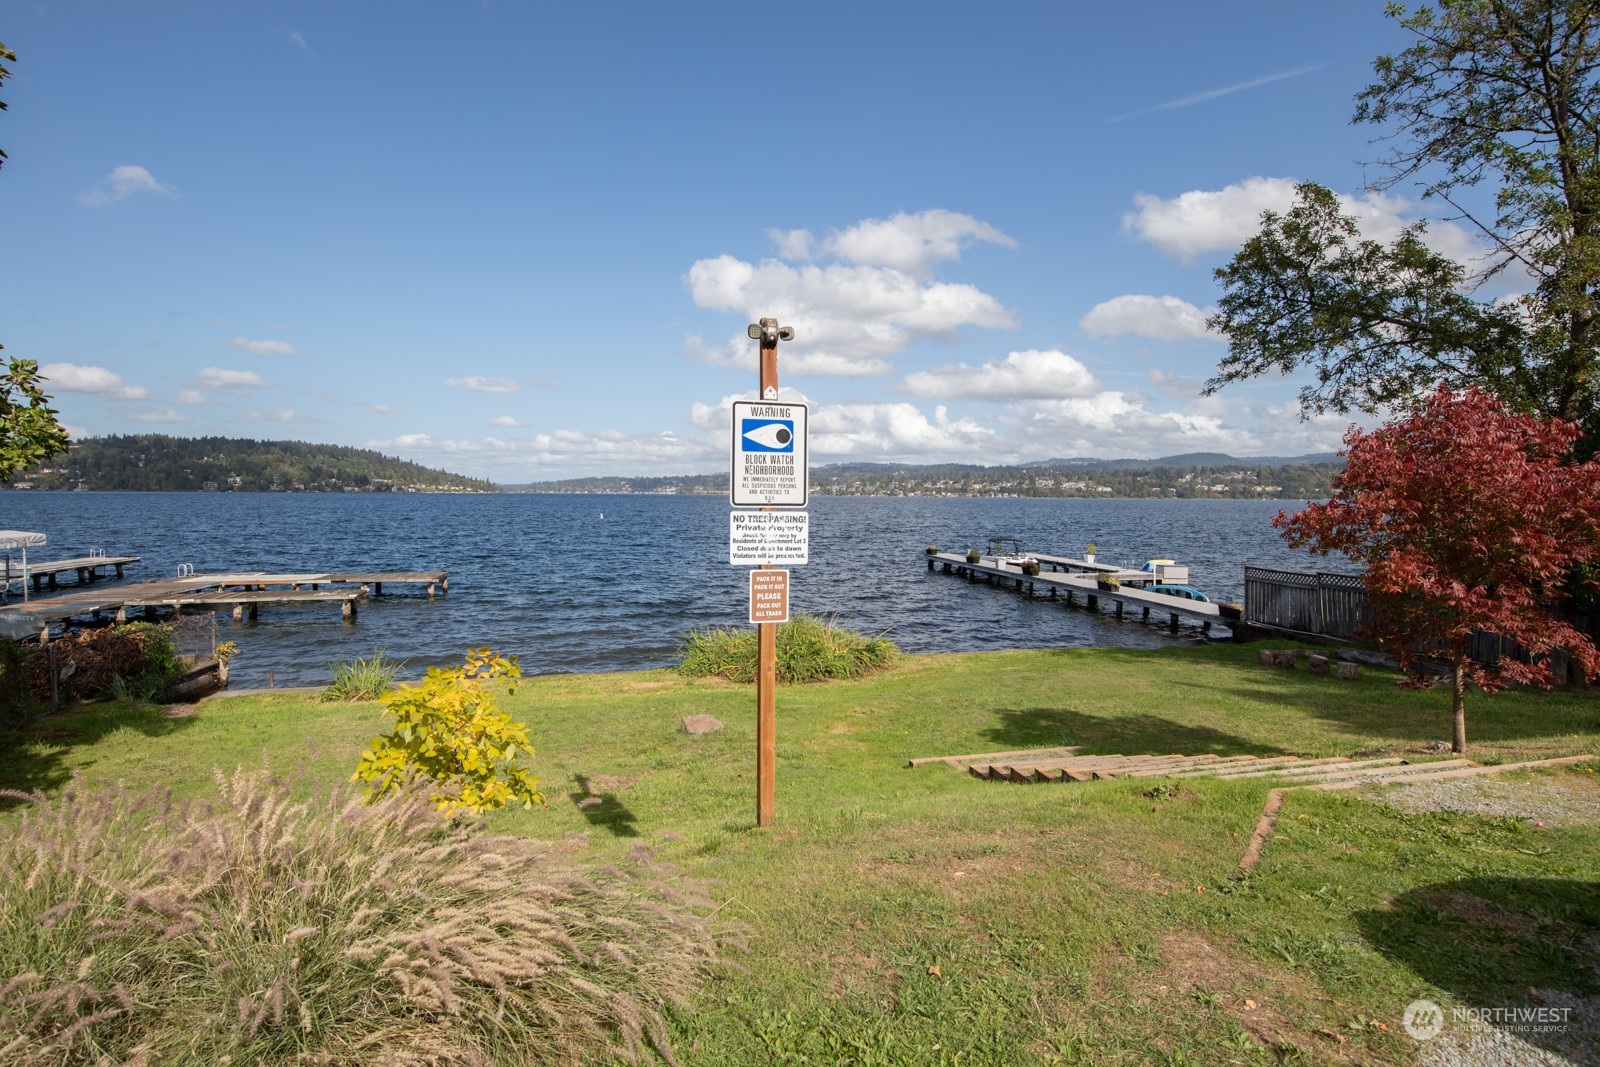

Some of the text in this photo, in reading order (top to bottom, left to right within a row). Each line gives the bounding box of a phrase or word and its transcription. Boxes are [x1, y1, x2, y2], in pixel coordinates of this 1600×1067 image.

[751, 407, 790, 418] WARNING
[746, 455, 794, 465] BLOCK WATCH
[745, 465, 794, 475] NEIGHBORHOOD
